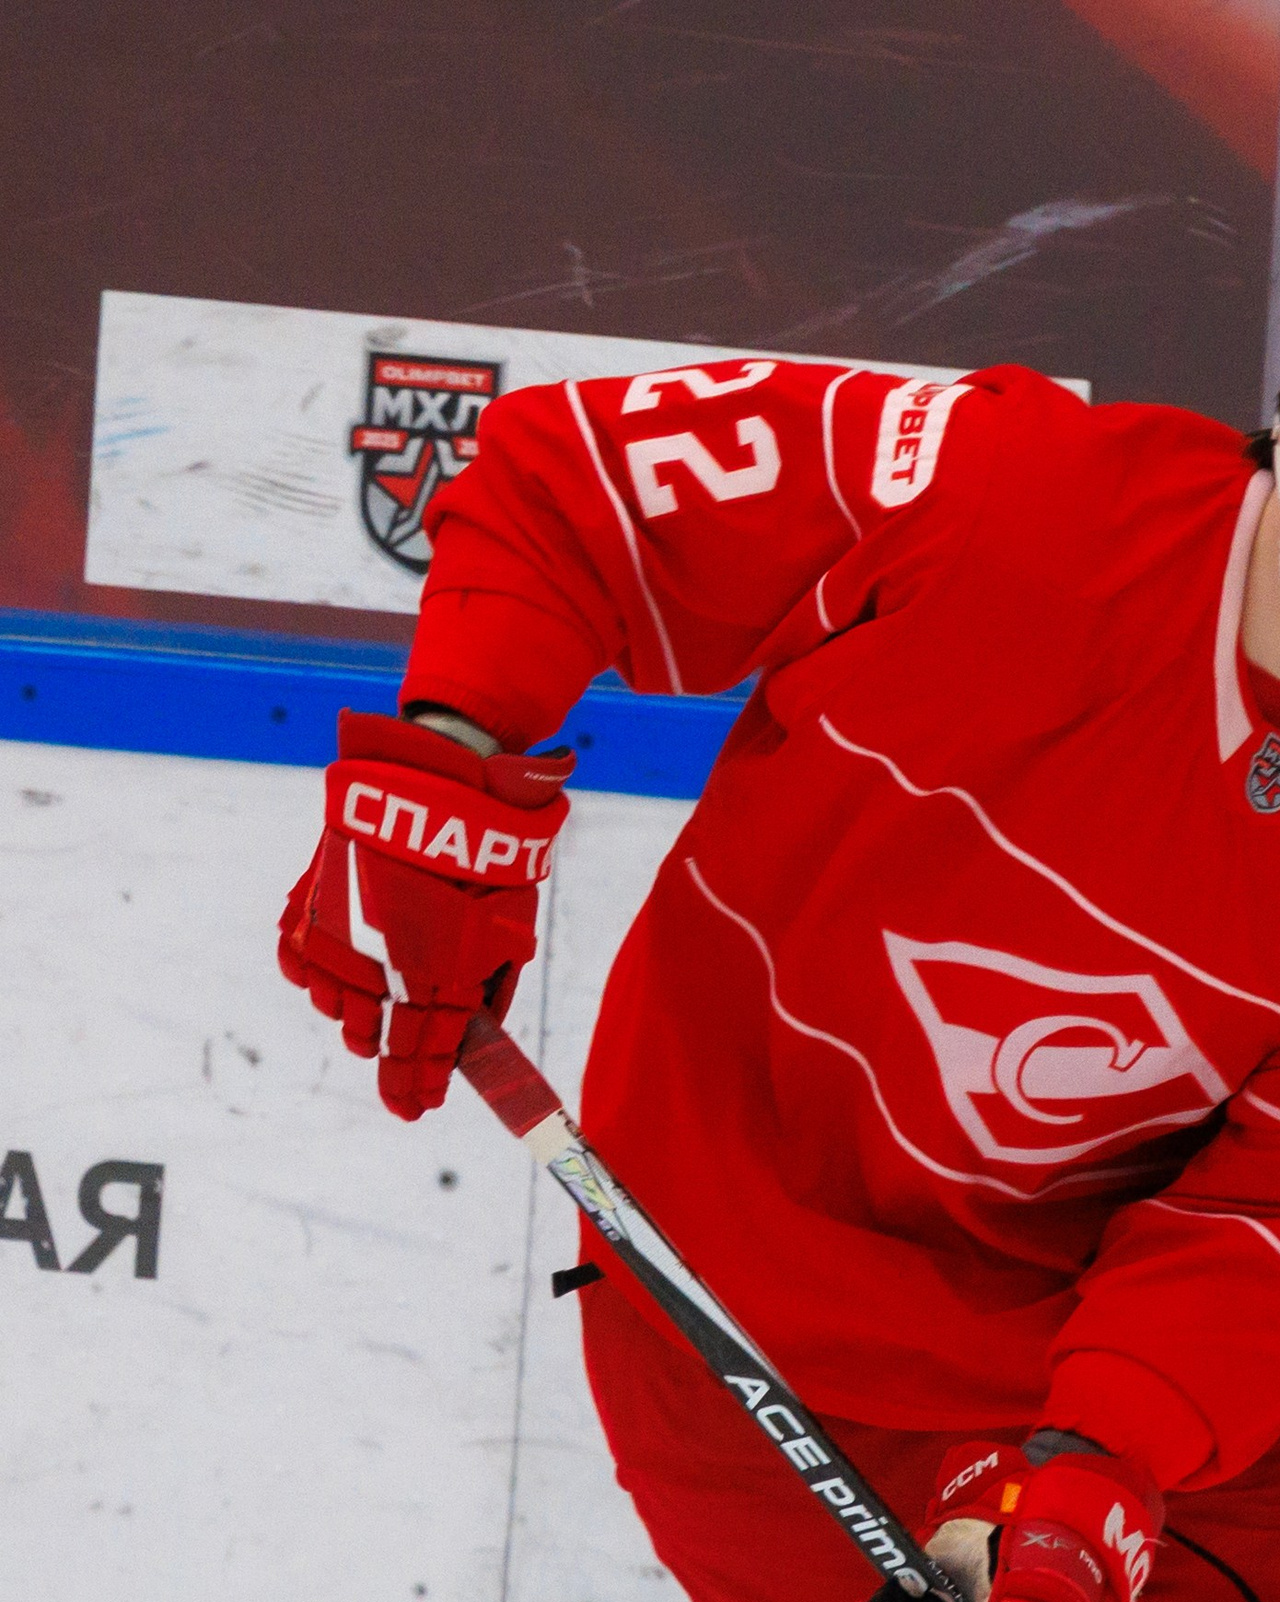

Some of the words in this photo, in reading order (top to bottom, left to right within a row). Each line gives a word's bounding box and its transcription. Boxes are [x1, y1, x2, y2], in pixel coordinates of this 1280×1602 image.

[621, 360, 782, 520] 22
[723, 1374, 832, 1471] ACE
[942, 1451, 999, 1501] CCM
